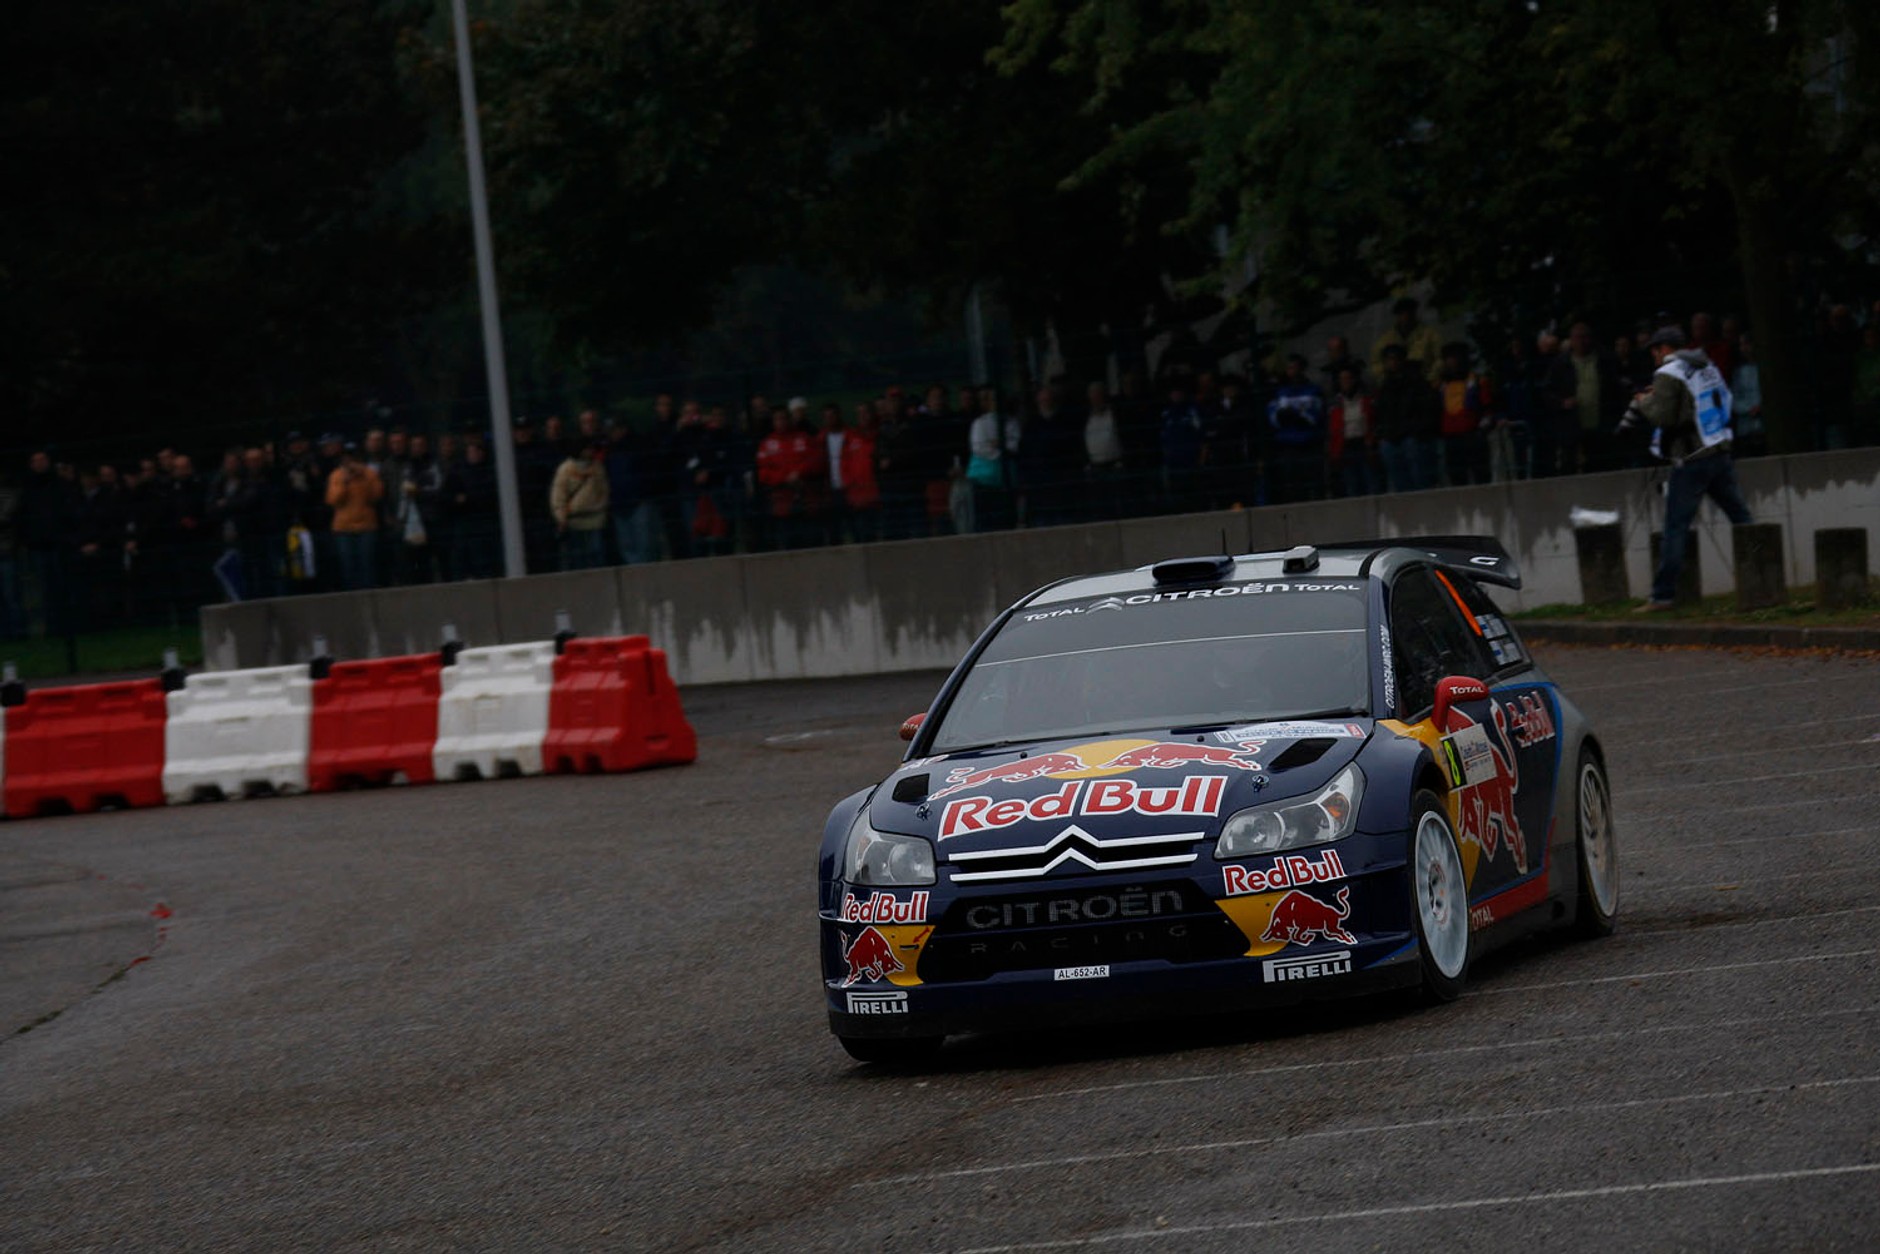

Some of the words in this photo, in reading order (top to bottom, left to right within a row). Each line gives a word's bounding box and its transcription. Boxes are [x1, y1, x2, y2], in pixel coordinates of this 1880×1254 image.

[1024, 606, 1086, 622] TOTAL
[1294, 582, 1361, 591] TOTAL
[1449, 686, 1485, 695] TOTAL
[938, 779, 1084, 841] Red
[1079, 776, 1228, 817] Bull
[1222, 856, 1291, 896] Red
[1286, 849, 1347, 886] Bull
[842, 891, 879, 923] Red
[874, 891, 930, 923] Bull
[1470, 905, 1495, 931] OTAL
[1057, 966, 1107, 979] AL-652-AR
[1262, 950, 1352, 984] PIRELLI
[846, 991, 909, 1014] PIRELLI
